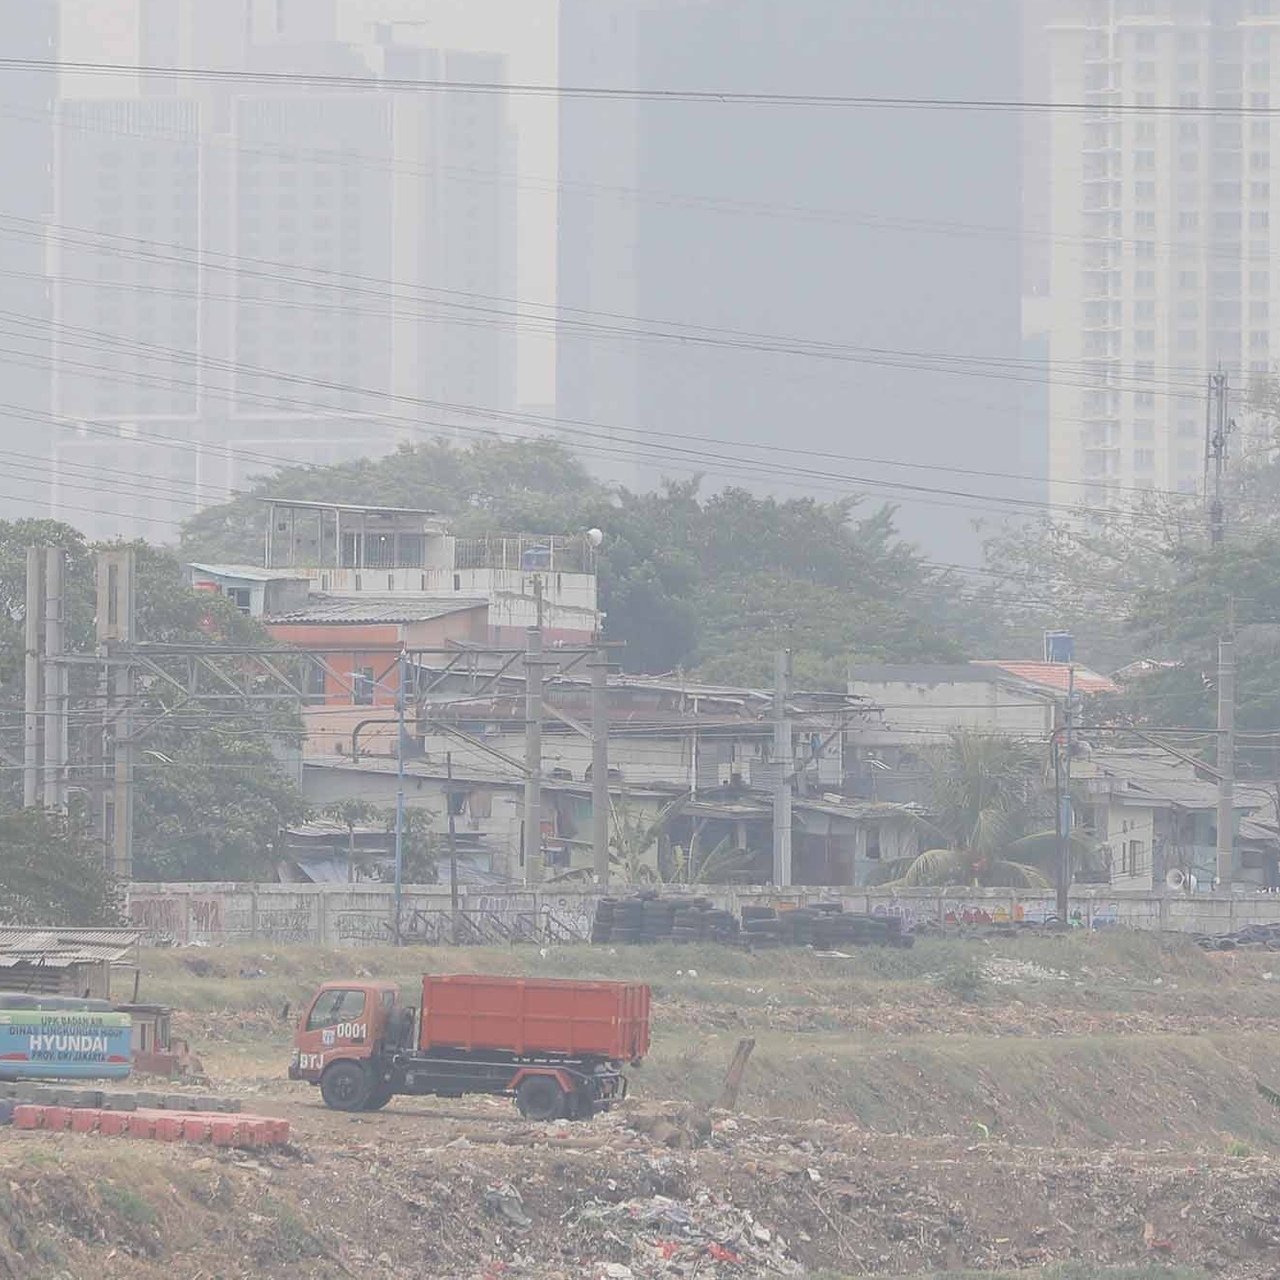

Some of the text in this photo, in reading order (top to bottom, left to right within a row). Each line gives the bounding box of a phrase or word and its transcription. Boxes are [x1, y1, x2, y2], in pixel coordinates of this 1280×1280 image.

[337, 1023, 367, 1039] 0001
[29, 1035, 108, 1052] HYUNDAI
[73, 1052, 106, 1062] JAKARTA
[300, 1054, 324, 1069] BTJ
